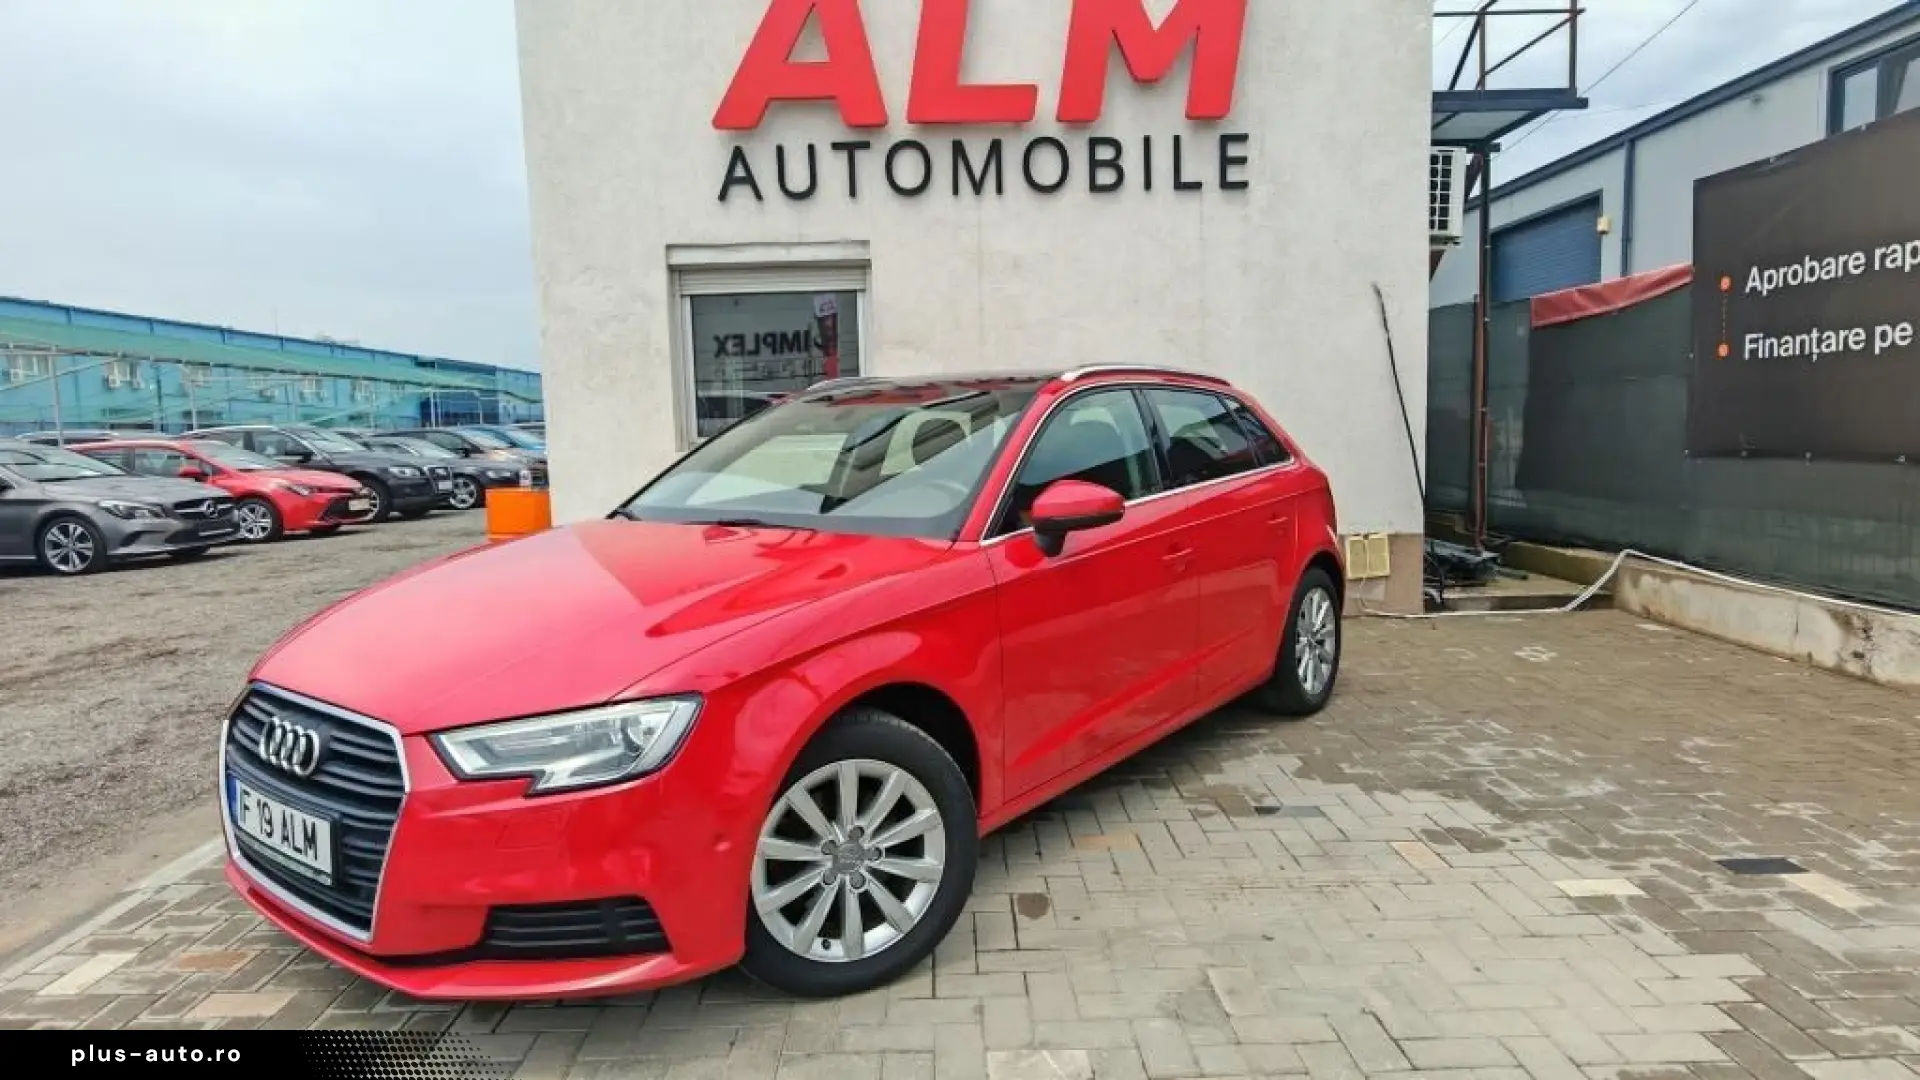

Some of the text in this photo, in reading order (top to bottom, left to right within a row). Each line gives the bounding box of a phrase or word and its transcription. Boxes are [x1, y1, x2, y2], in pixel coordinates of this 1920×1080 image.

[712, 0, 1247, 129] ALM
[718, 133, 1250, 201] AUTOMOBILE
[1745, 251, 1867, 297] Aprobare
[1744, 321, 1914, 363] Finanțare pe
[256, 798, 274, 839] 19
[281, 808, 318, 861] ALM
